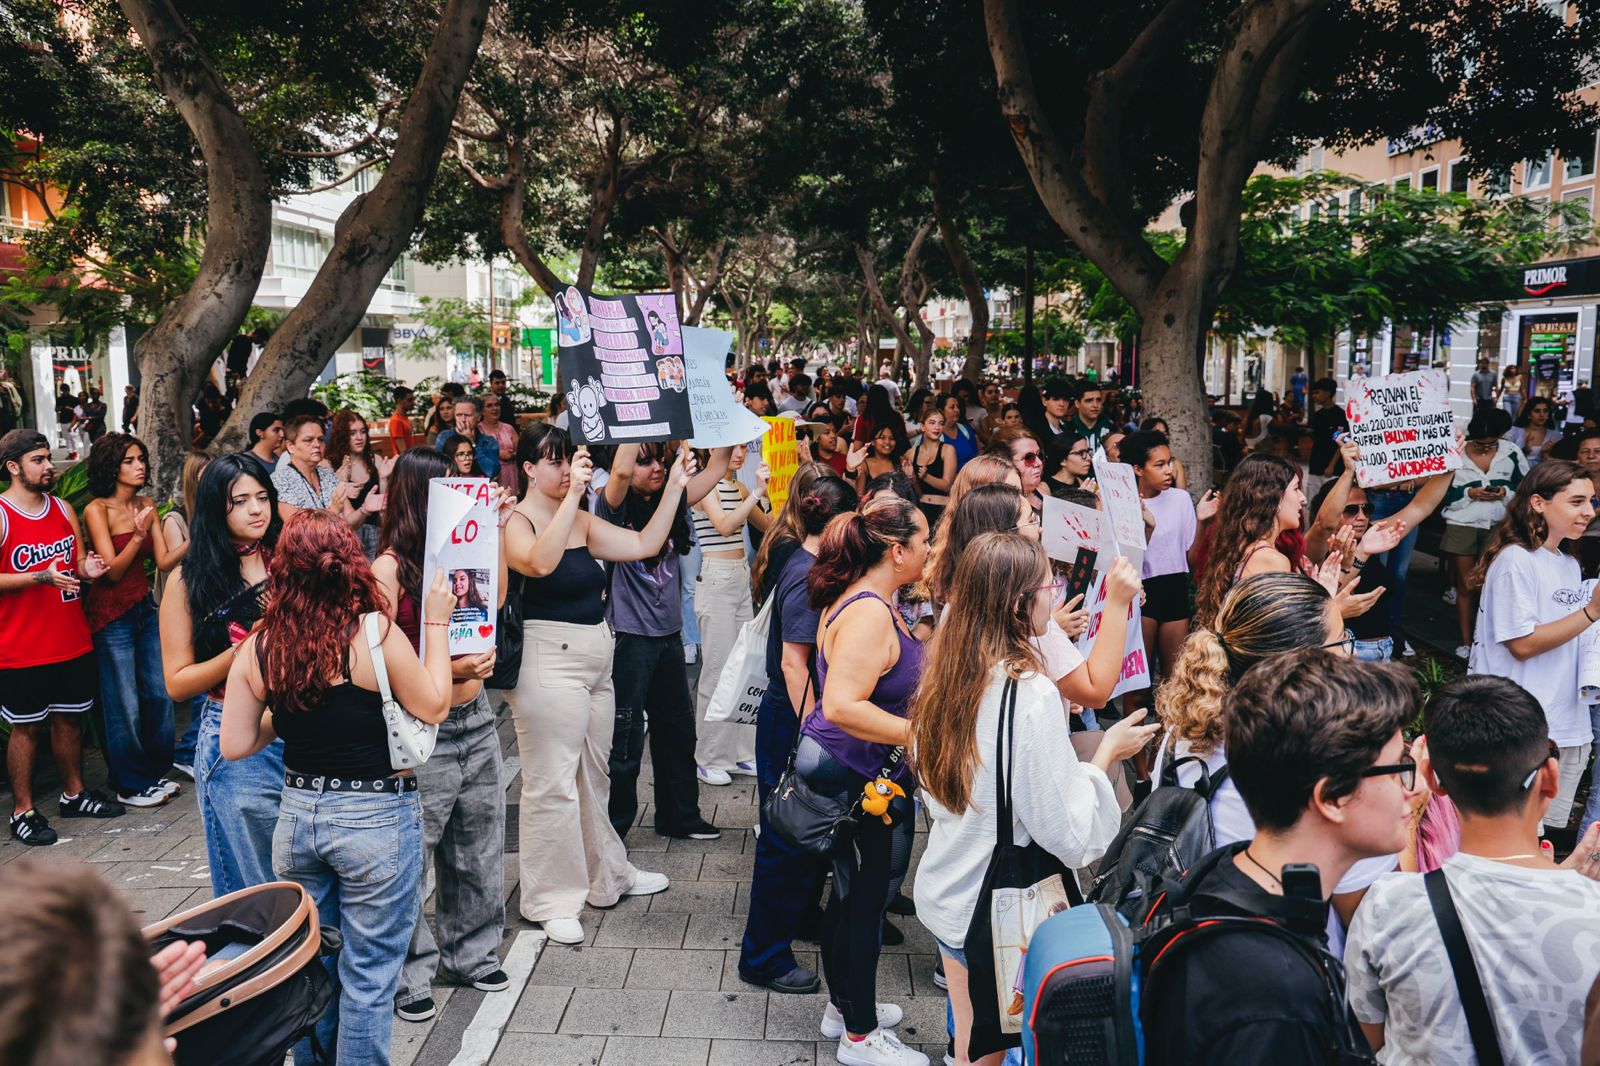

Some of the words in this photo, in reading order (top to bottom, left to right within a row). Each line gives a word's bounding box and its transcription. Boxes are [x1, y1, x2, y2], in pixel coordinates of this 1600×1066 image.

[1524, 266, 1567, 285] PRIMOR
[394, 328, 428, 339] BBVA
[1410, 386, 1422, 400] EL
[1353, 423, 1369, 434] CASI
[1370, 417, 1403, 431] 220.000
[1407, 411, 1453, 427] ESTUDIANTE
[768, 421, 785, 446] POR
[1353, 433, 1383, 446] SUFREN
[1384, 429, 1417, 446] BULLYNG
[1440, 425, 1451, 437] DE
[1392, 442, 1449, 461] INTENTARON
[1387, 456, 1446, 479] SUICIDARSE
[739, 702, 753, 713] en
